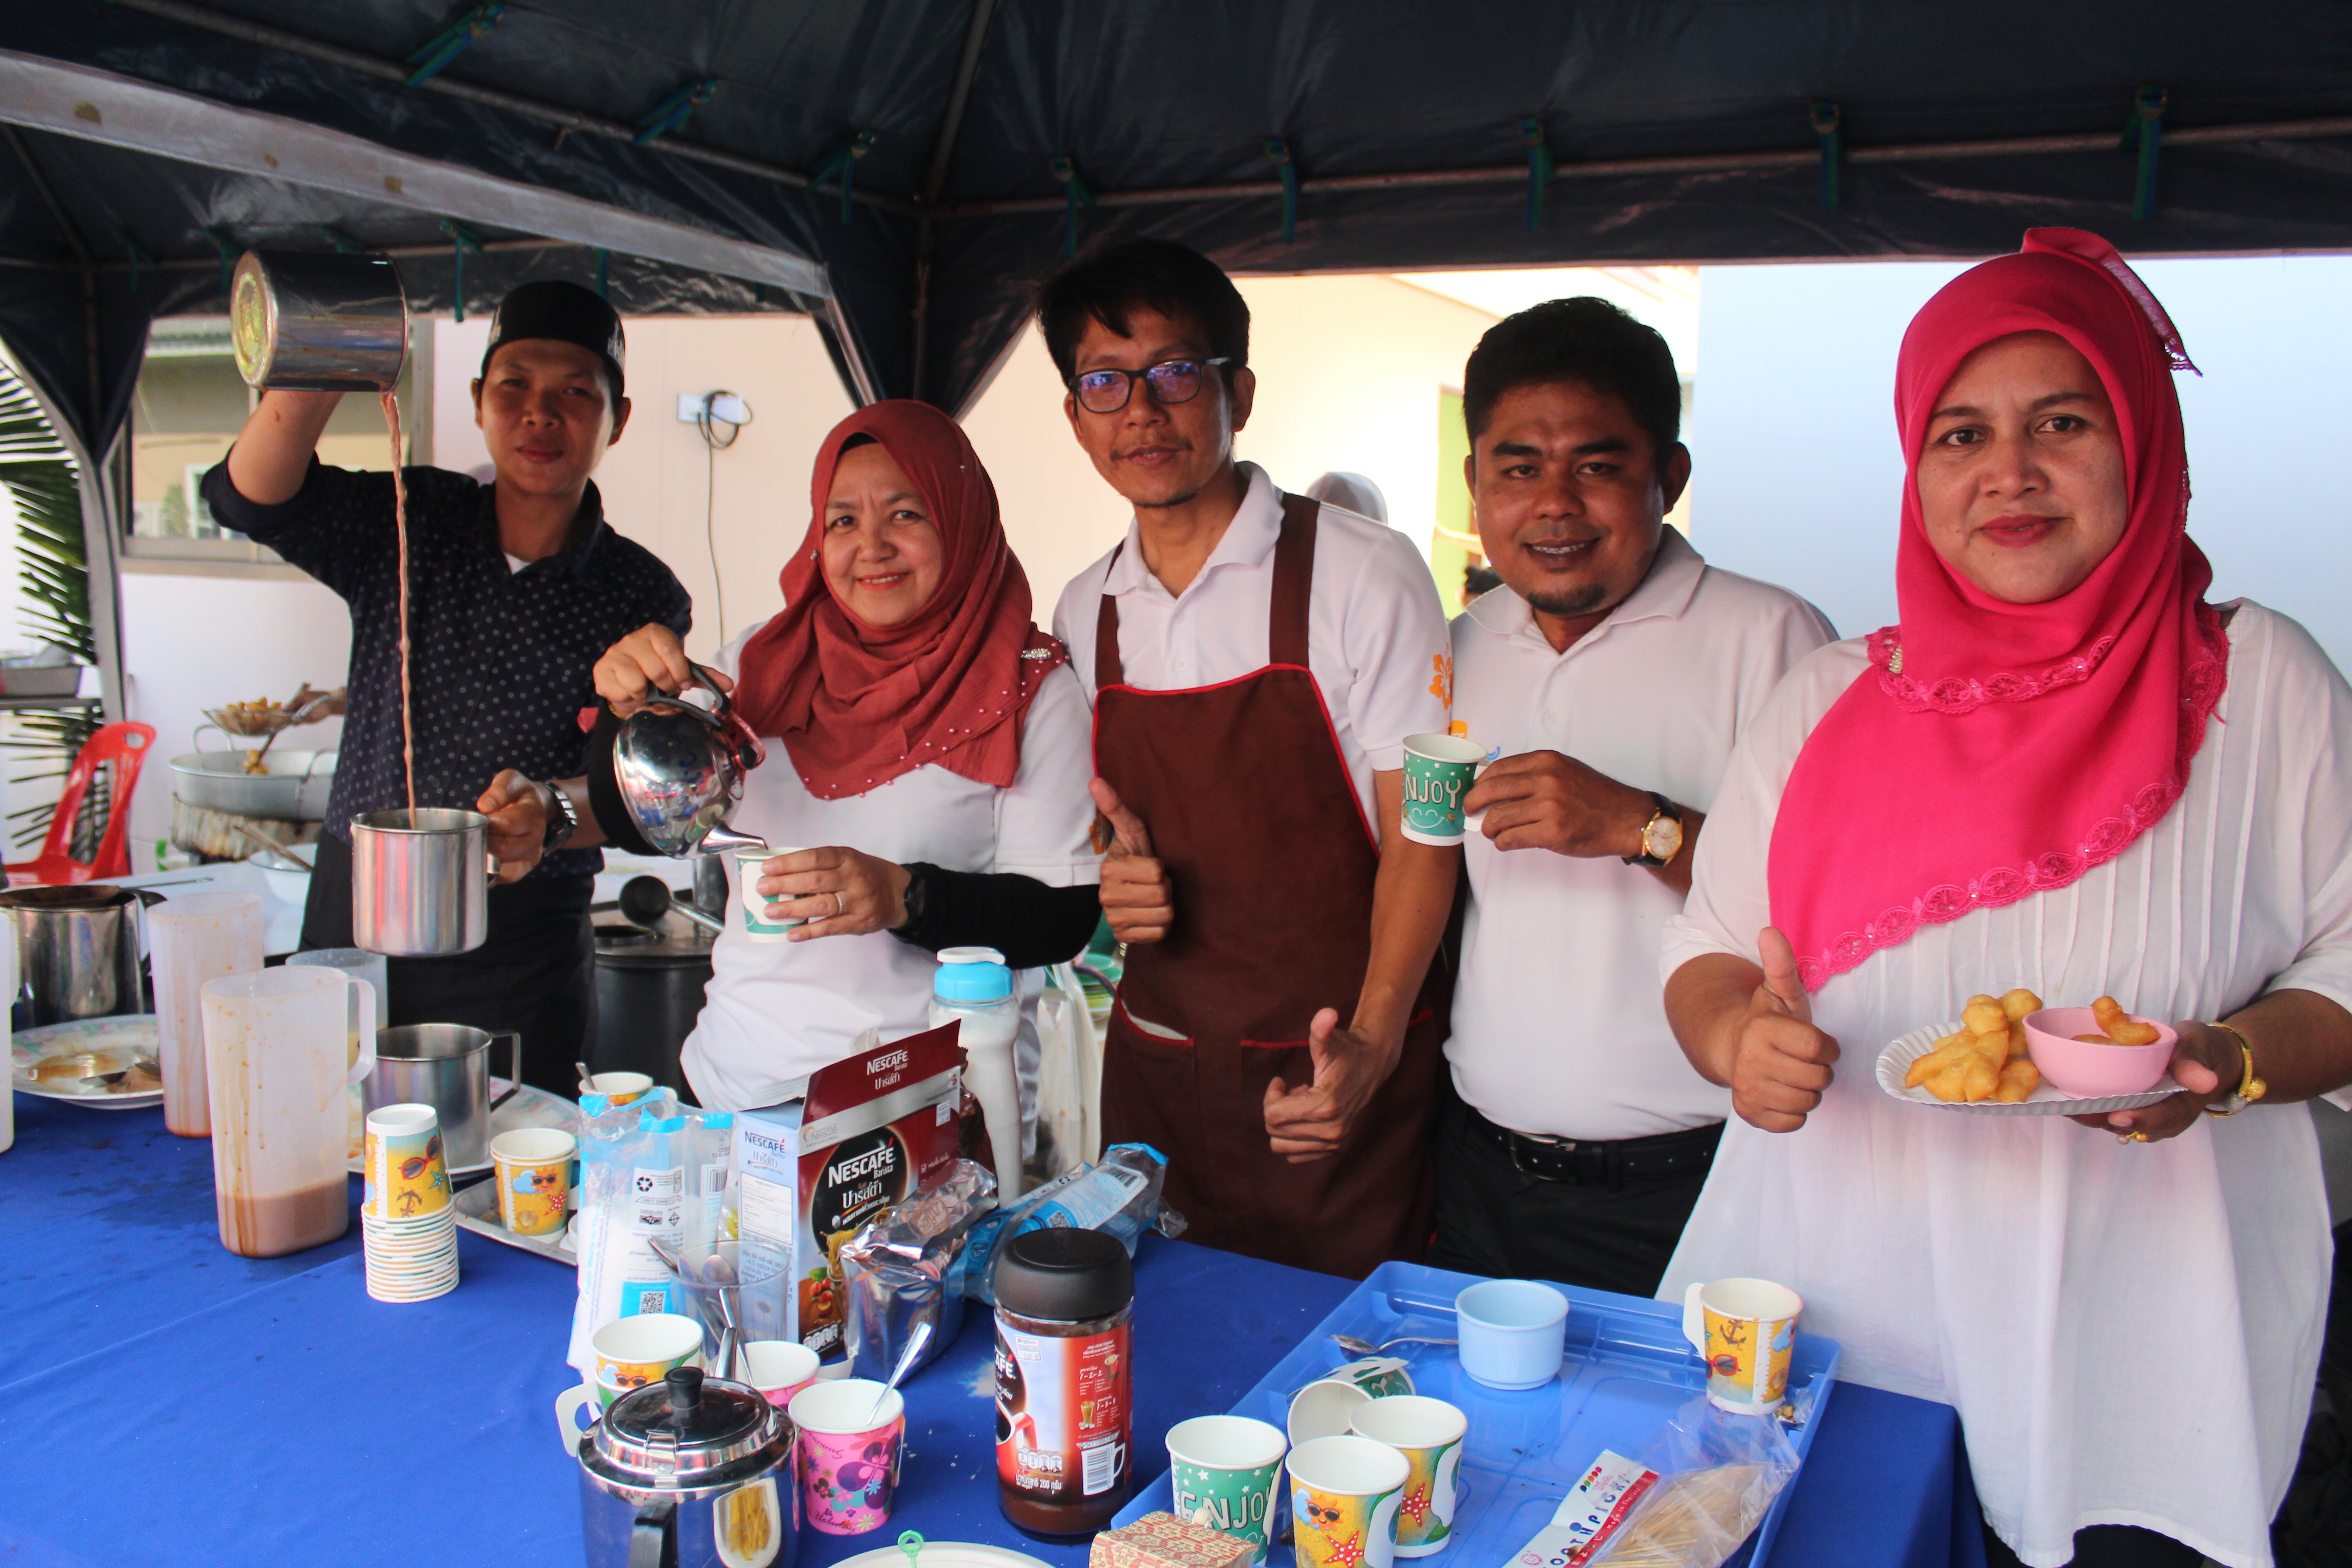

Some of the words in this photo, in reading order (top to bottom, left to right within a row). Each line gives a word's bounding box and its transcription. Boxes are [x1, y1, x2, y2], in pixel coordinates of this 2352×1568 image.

[1405, 773, 1461, 810] NJOY
[828, 1137, 894, 1188] NESCAFÉ
[873, 1165, 893, 1179] Barista
[1039, 1479, 1050, 1489] 200
